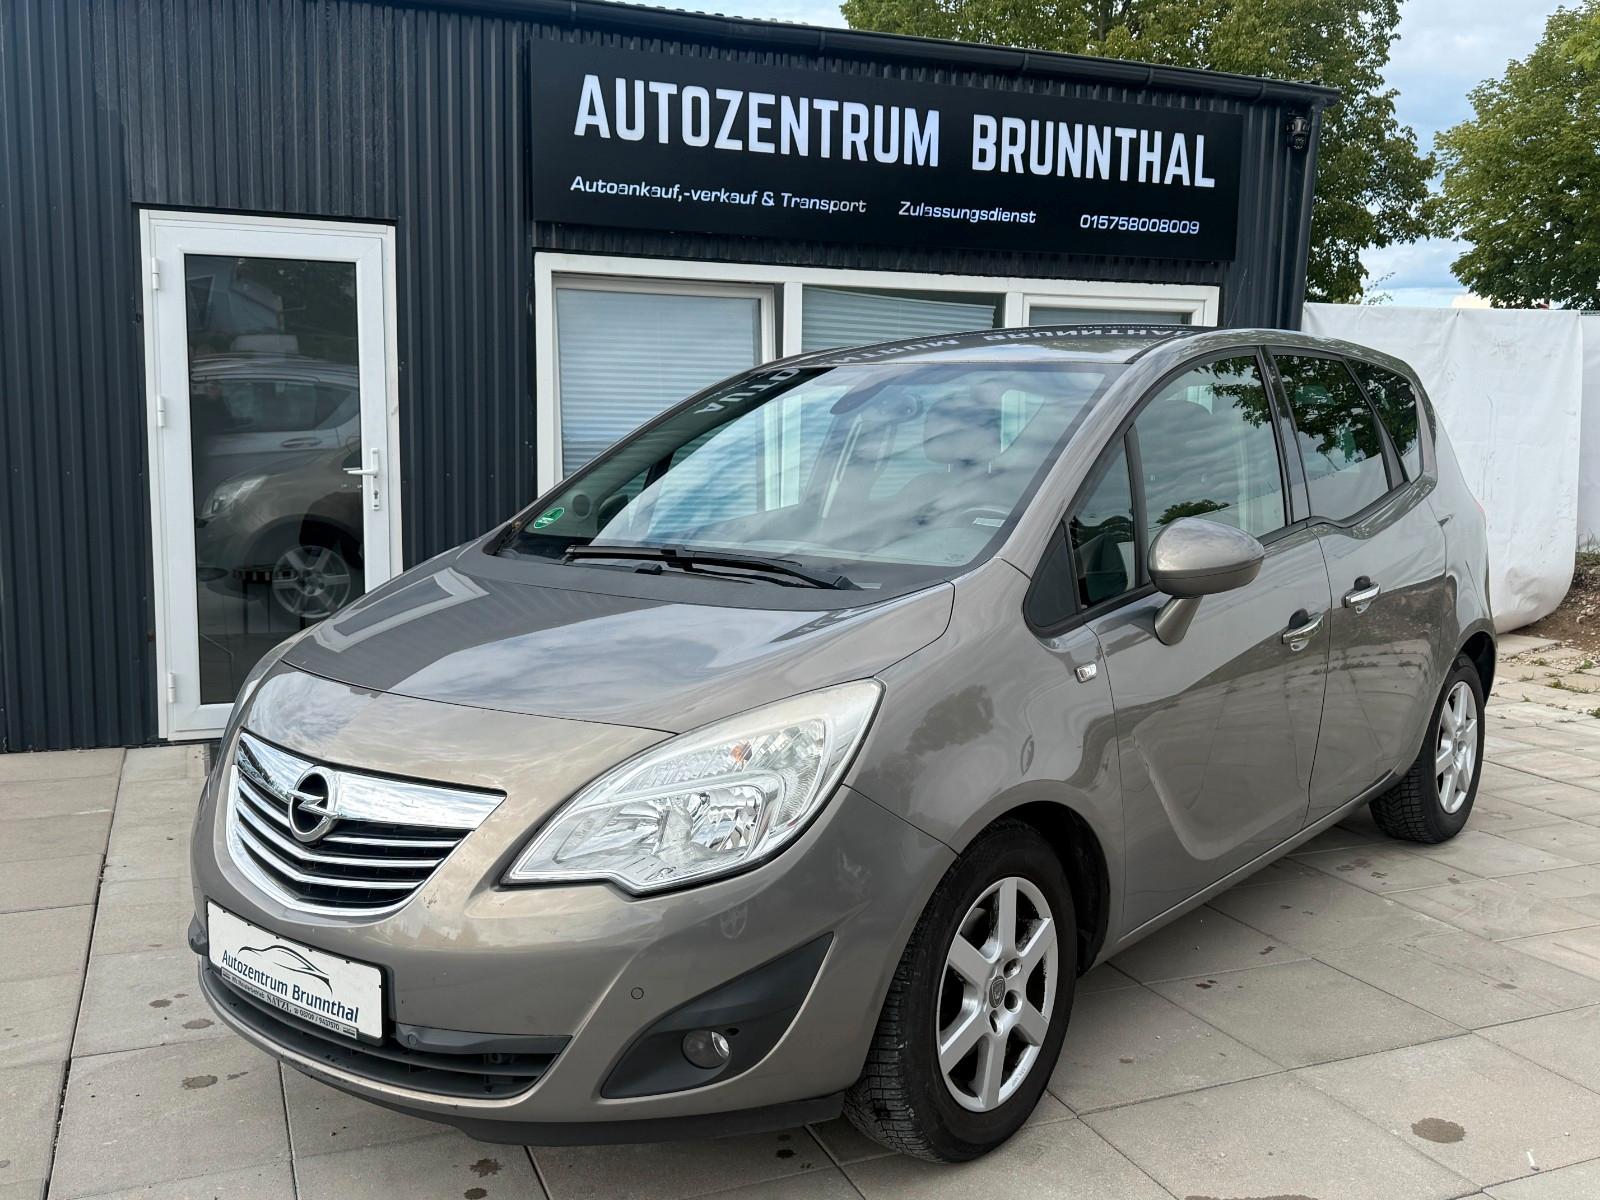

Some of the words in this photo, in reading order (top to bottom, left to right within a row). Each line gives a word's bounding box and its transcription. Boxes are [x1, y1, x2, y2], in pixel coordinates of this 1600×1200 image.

[573, 74, 940, 167] AUTOZENTRUM
[972, 114, 1216, 188] BRUNNTHAL
[570, 176, 758, 206] Autoankauf,-verkauf
[761, 192, 775, 206] &
[781, 192, 867, 214] Transport
[899, 201, 1037, 224] Zulassungsdienst
[1079, 214, 1200, 235] 015758008009
[222, 950, 288, 997] Autozentrum
[292, 984, 359, 1023] Brunnthal
